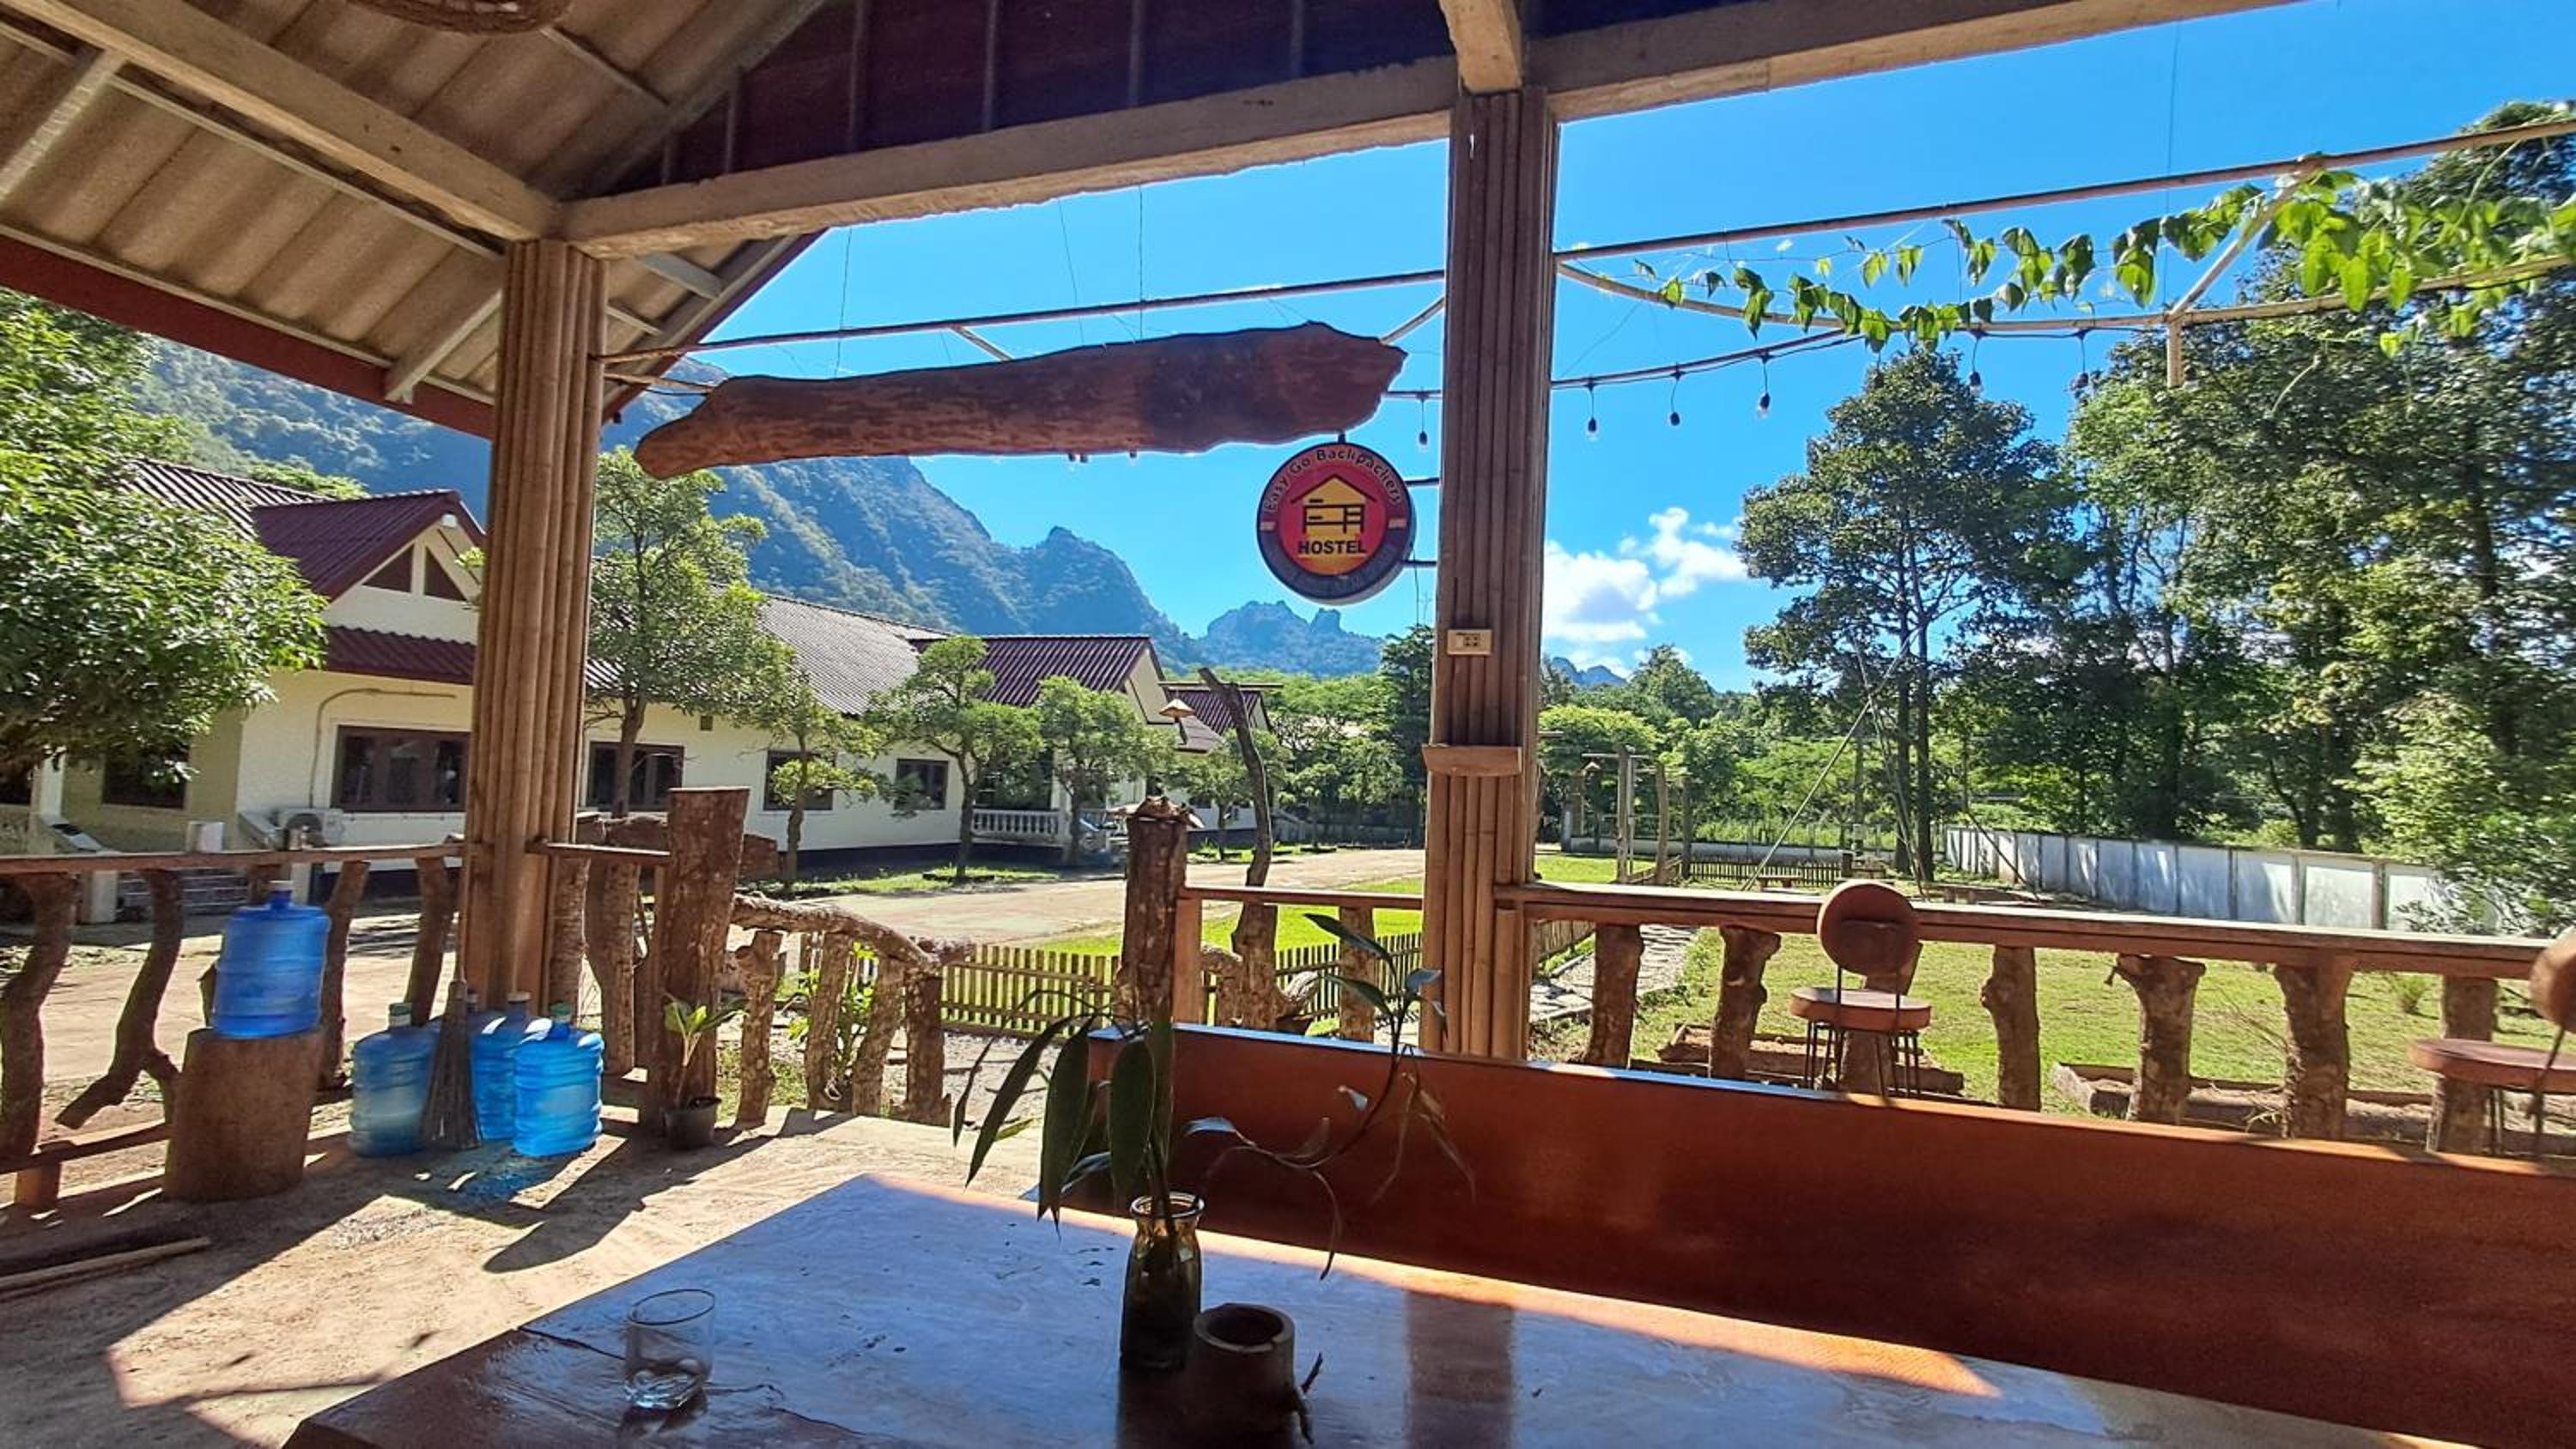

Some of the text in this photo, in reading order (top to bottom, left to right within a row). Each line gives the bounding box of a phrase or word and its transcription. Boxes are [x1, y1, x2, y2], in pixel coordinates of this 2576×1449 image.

[1264, 449, 1401, 512] Easy Go Backpackers
[1297, 540, 1368, 554] HOSTEL
